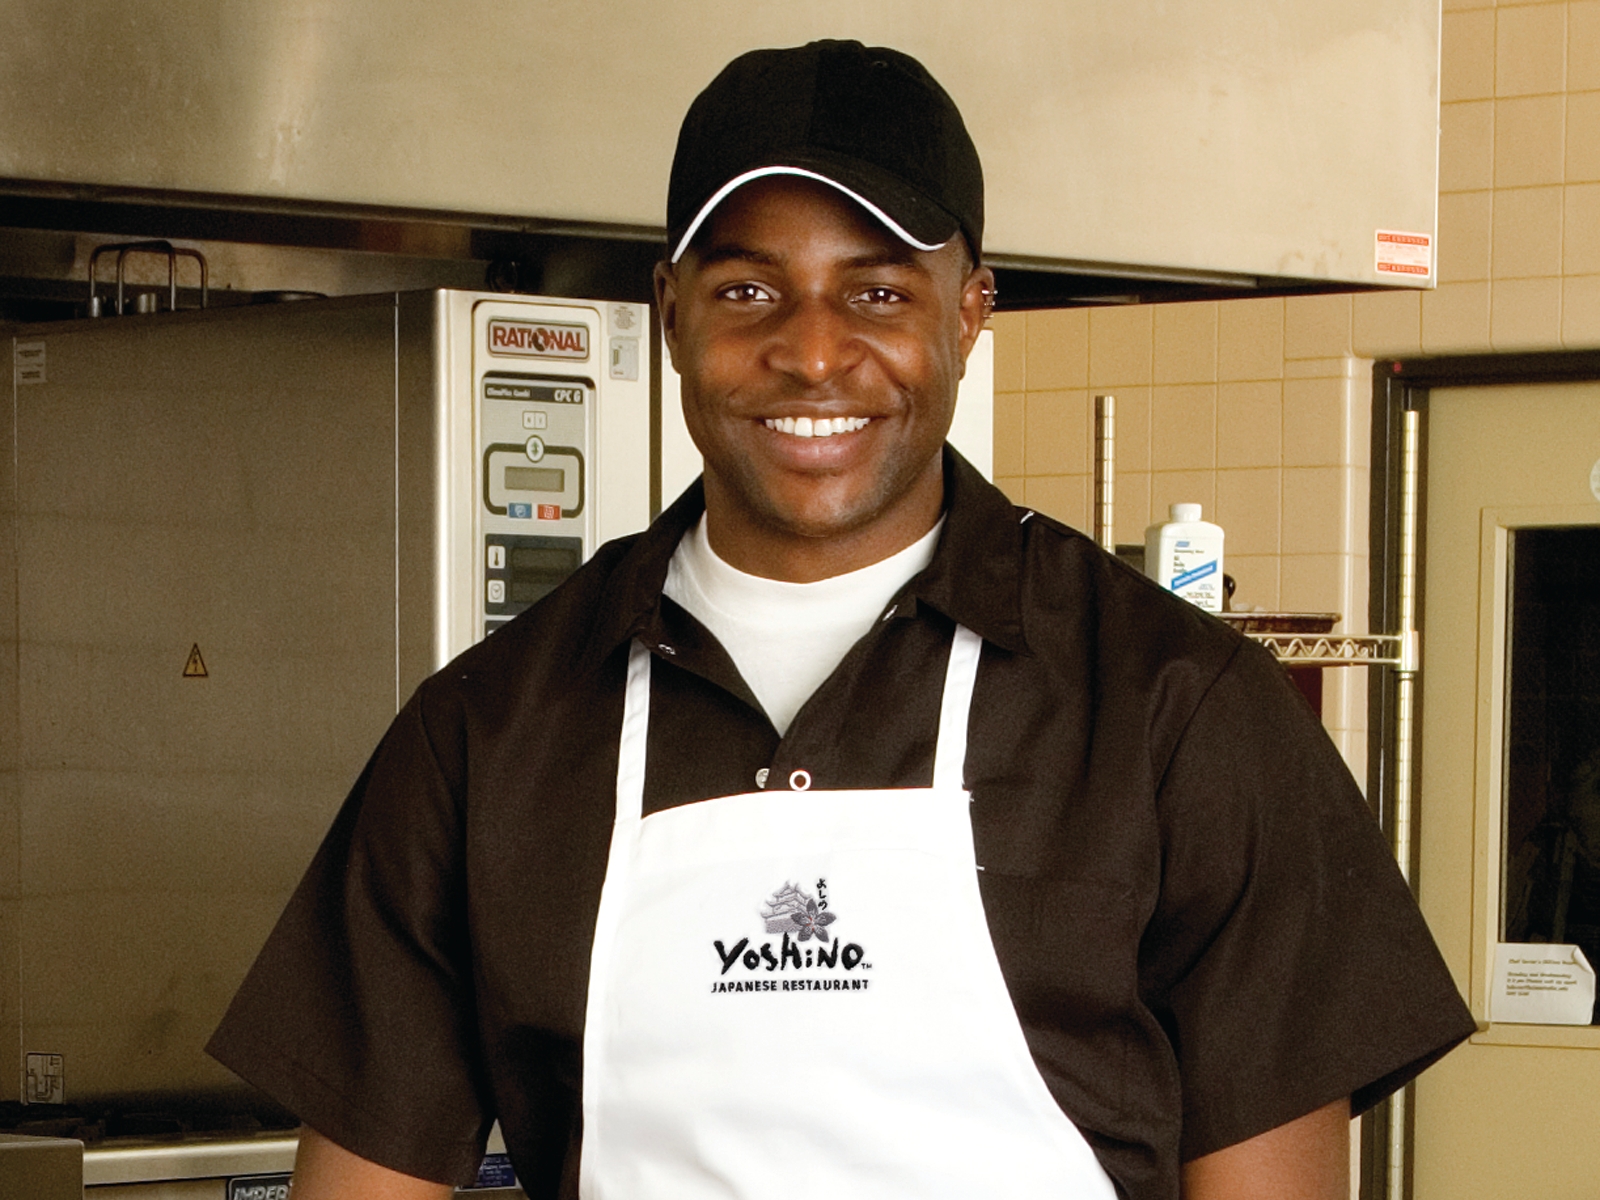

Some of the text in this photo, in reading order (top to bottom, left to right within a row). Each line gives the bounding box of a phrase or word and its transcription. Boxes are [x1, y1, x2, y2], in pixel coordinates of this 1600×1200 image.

[492, 325, 585, 352] RATIONAL
[711, 979, 869, 993] JAPANESE RESTAURANT
